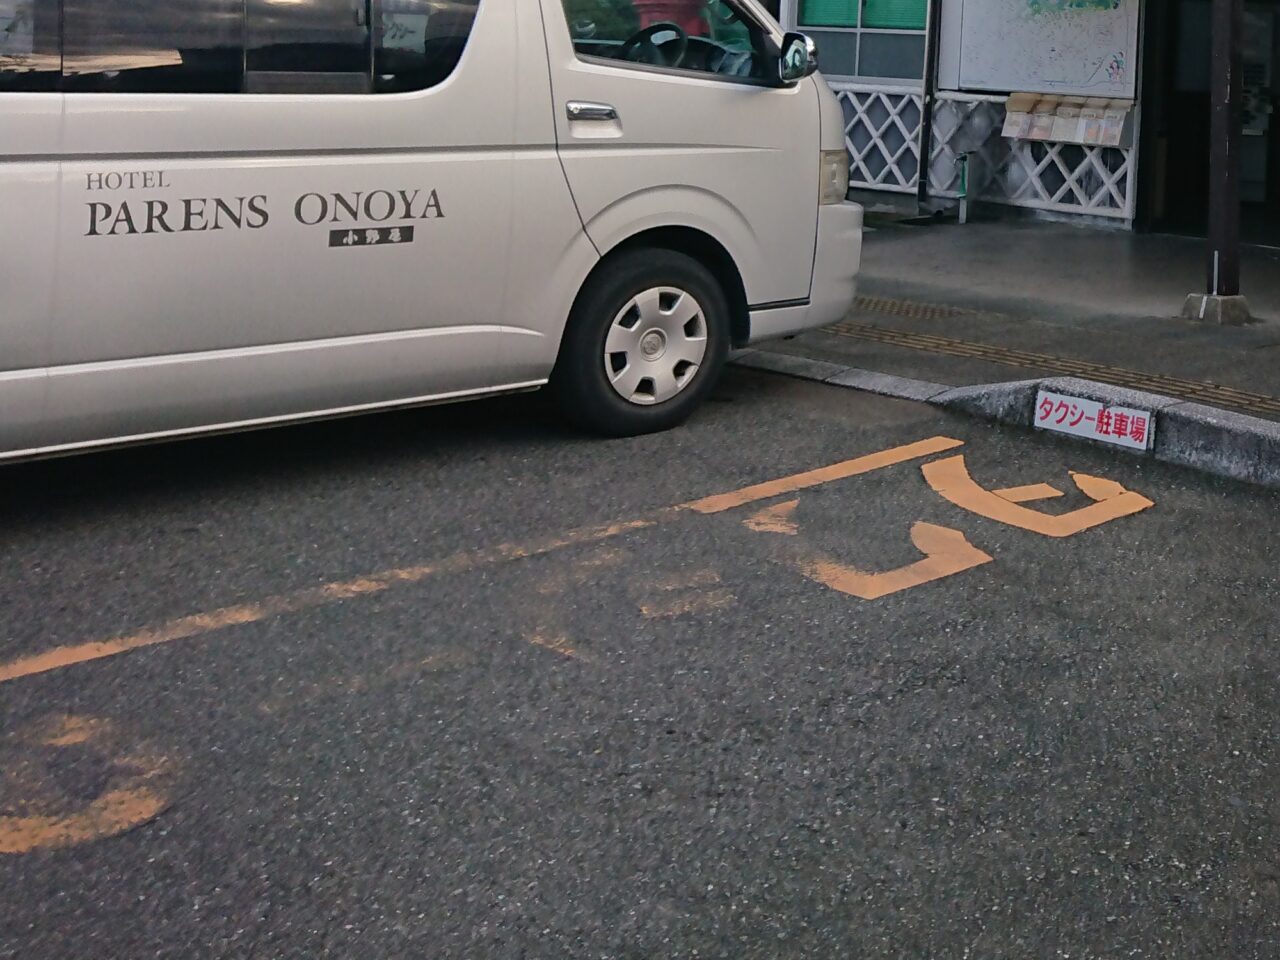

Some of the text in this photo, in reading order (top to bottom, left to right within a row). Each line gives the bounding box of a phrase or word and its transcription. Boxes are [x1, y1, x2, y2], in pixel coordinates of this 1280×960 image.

[85, 170, 170, 191] HOTEL
[84, 188, 446, 237] PARENS ONOYA
[1038, 396, 1147, 444] タクシー駐車場
